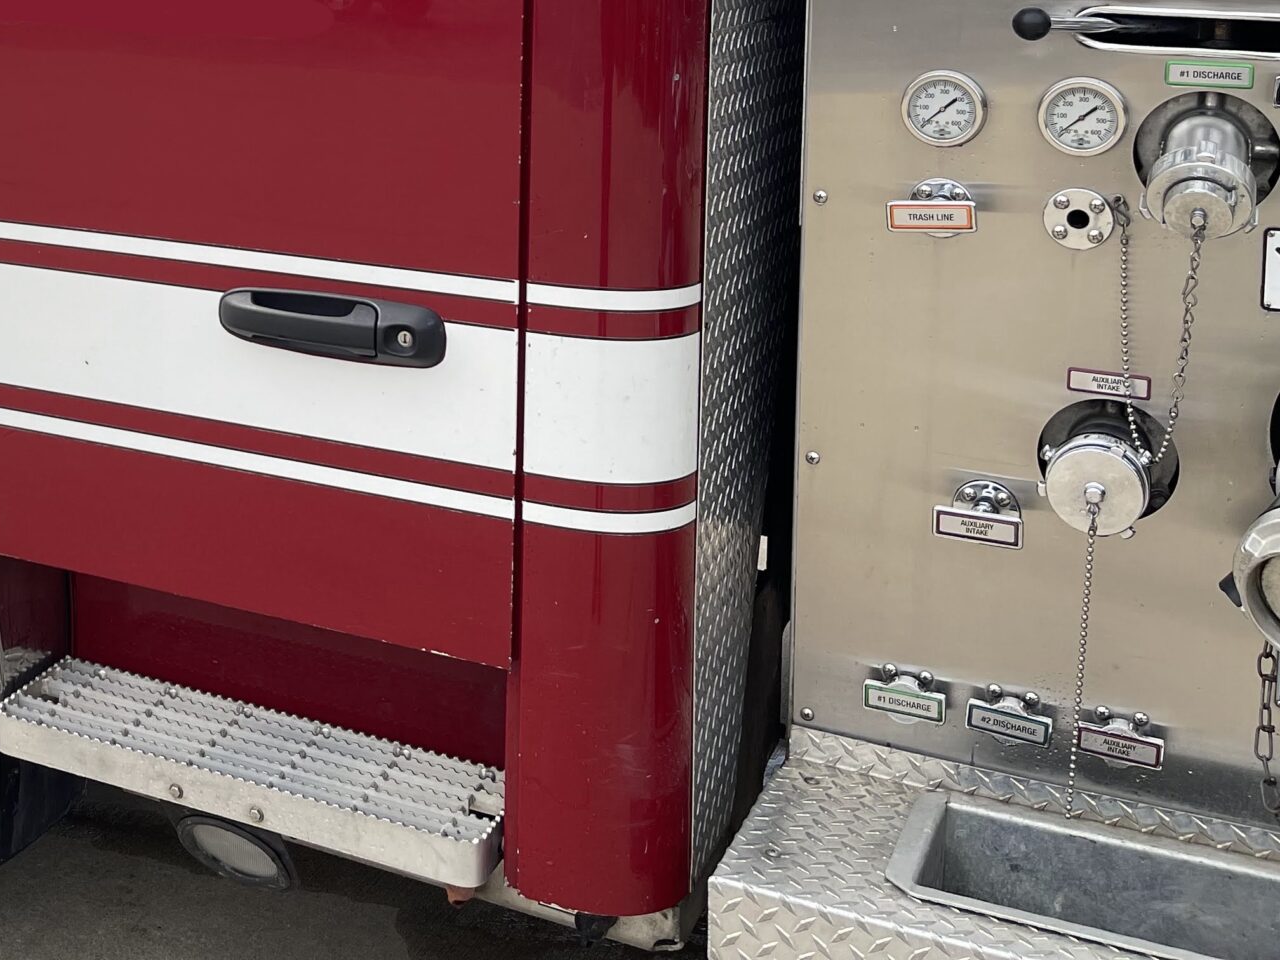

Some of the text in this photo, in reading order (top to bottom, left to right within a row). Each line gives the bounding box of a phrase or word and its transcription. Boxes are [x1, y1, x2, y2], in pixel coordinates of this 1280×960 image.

[1192, 70, 1242, 80] DISCHARGE
[908, 213, 955, 221] TRASH LINE
[1097, 383, 1120, 391] INTAKE
[961, 520, 994, 530] AUXILIARY
[966, 527, 988, 536] INTAKE
[877, 695, 932, 712] #1 DISCHARGE
[981, 716, 1038, 736] #2 DISCHARGE
[1103, 738, 1136, 751] AUXILIARY
[1107, 746, 1131, 756] INTAKE
